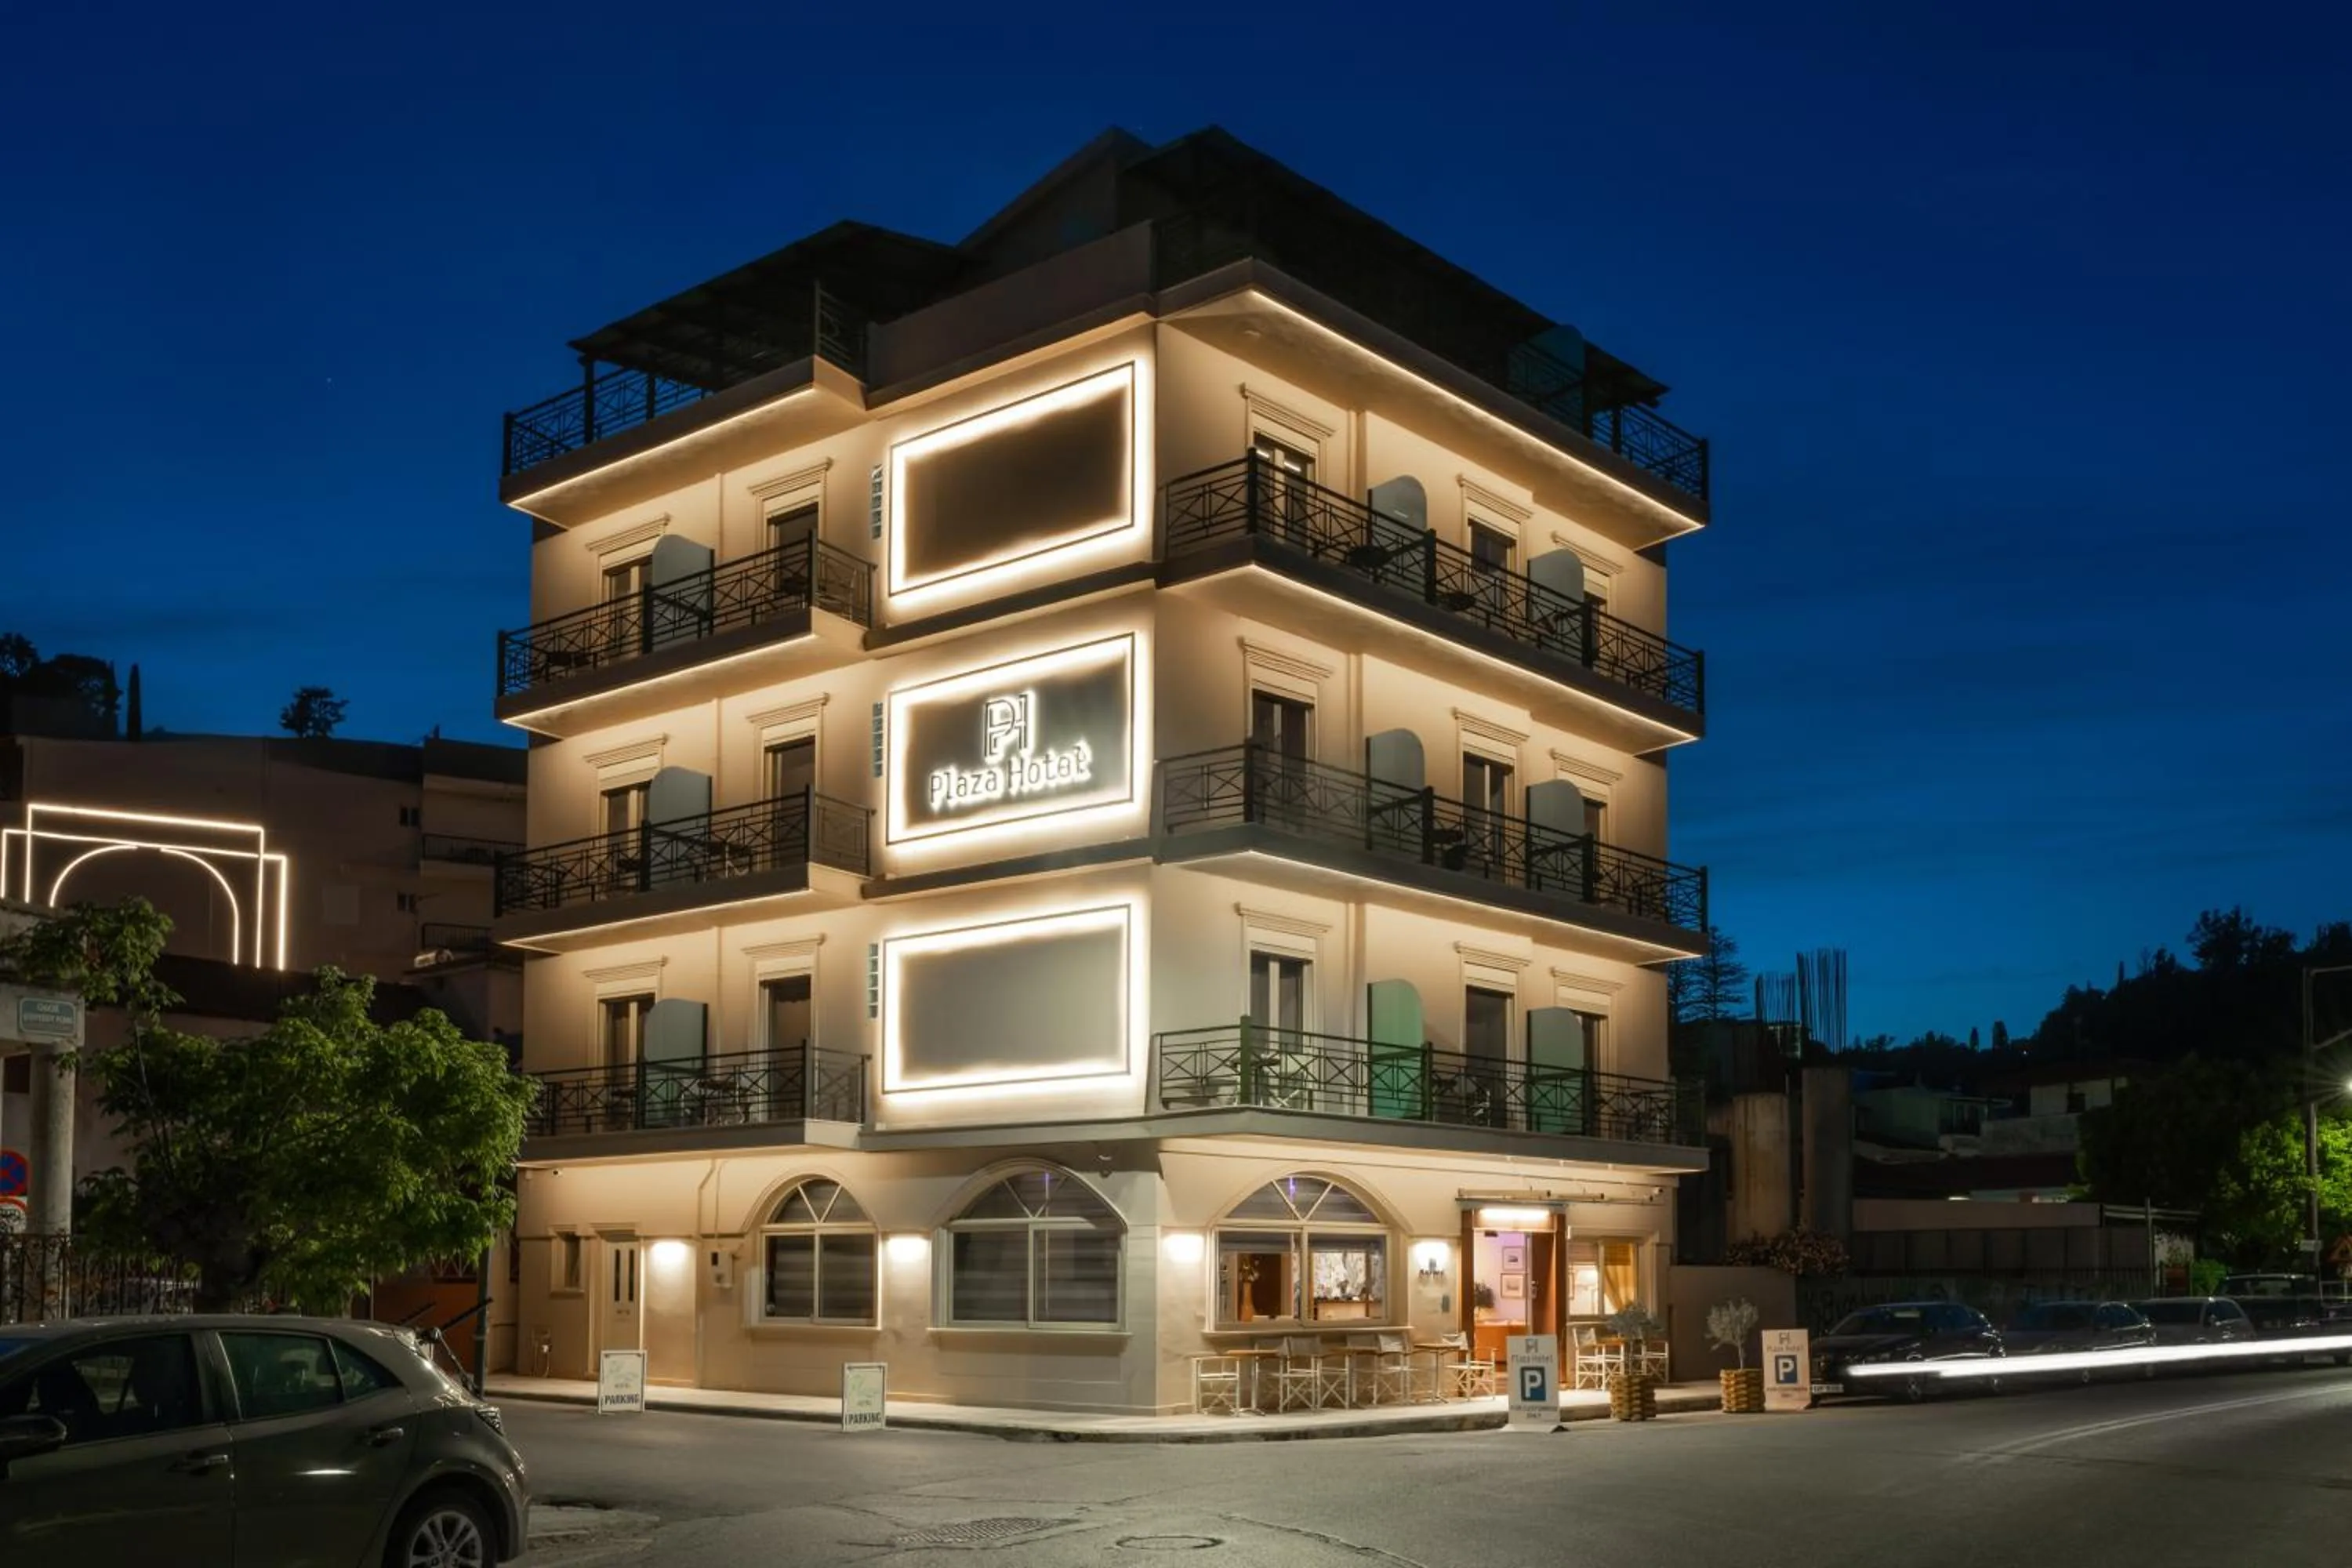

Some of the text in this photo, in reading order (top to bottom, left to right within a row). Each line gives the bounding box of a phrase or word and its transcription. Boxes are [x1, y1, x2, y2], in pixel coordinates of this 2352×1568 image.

[931, 745, 1088, 804] Plaza Hotel
[1512, 1354, 1553, 1363] Plaza Hotel
[1778, 1358, 1795, 1381] P
[1524, 1370, 1542, 1399] P
[604, 1392, 640, 1406] PARKING
[848, 1411, 882, 1425] PARKING
